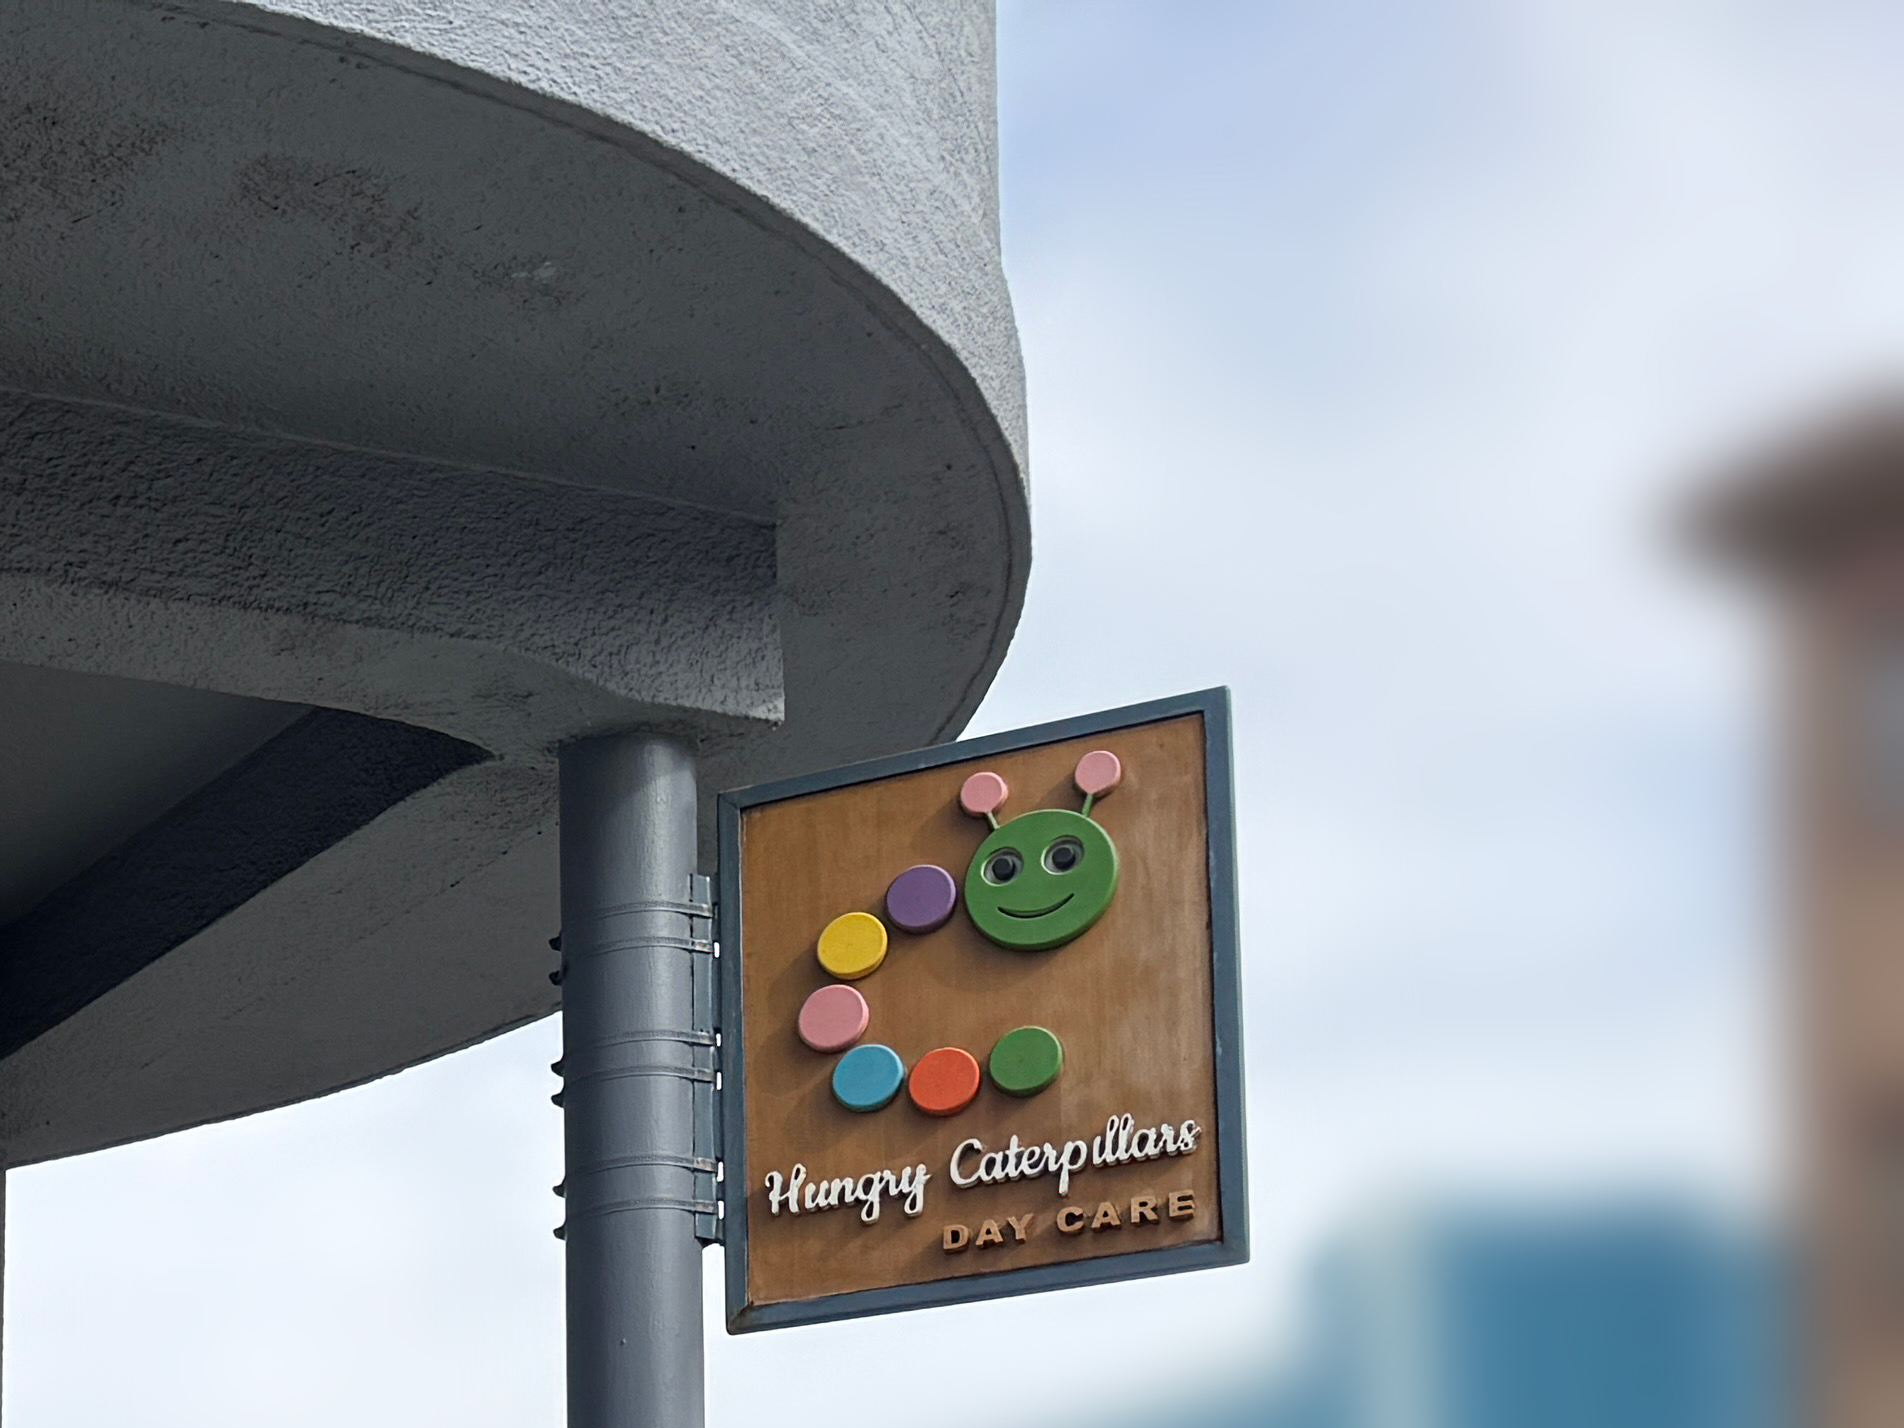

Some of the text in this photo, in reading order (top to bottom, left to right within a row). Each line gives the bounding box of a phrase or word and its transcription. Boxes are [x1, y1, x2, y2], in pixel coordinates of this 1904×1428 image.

[764, 1113, 1200, 1223] Hungry Caterpillars
[942, 1192, 1196, 1252] DAY CARE
